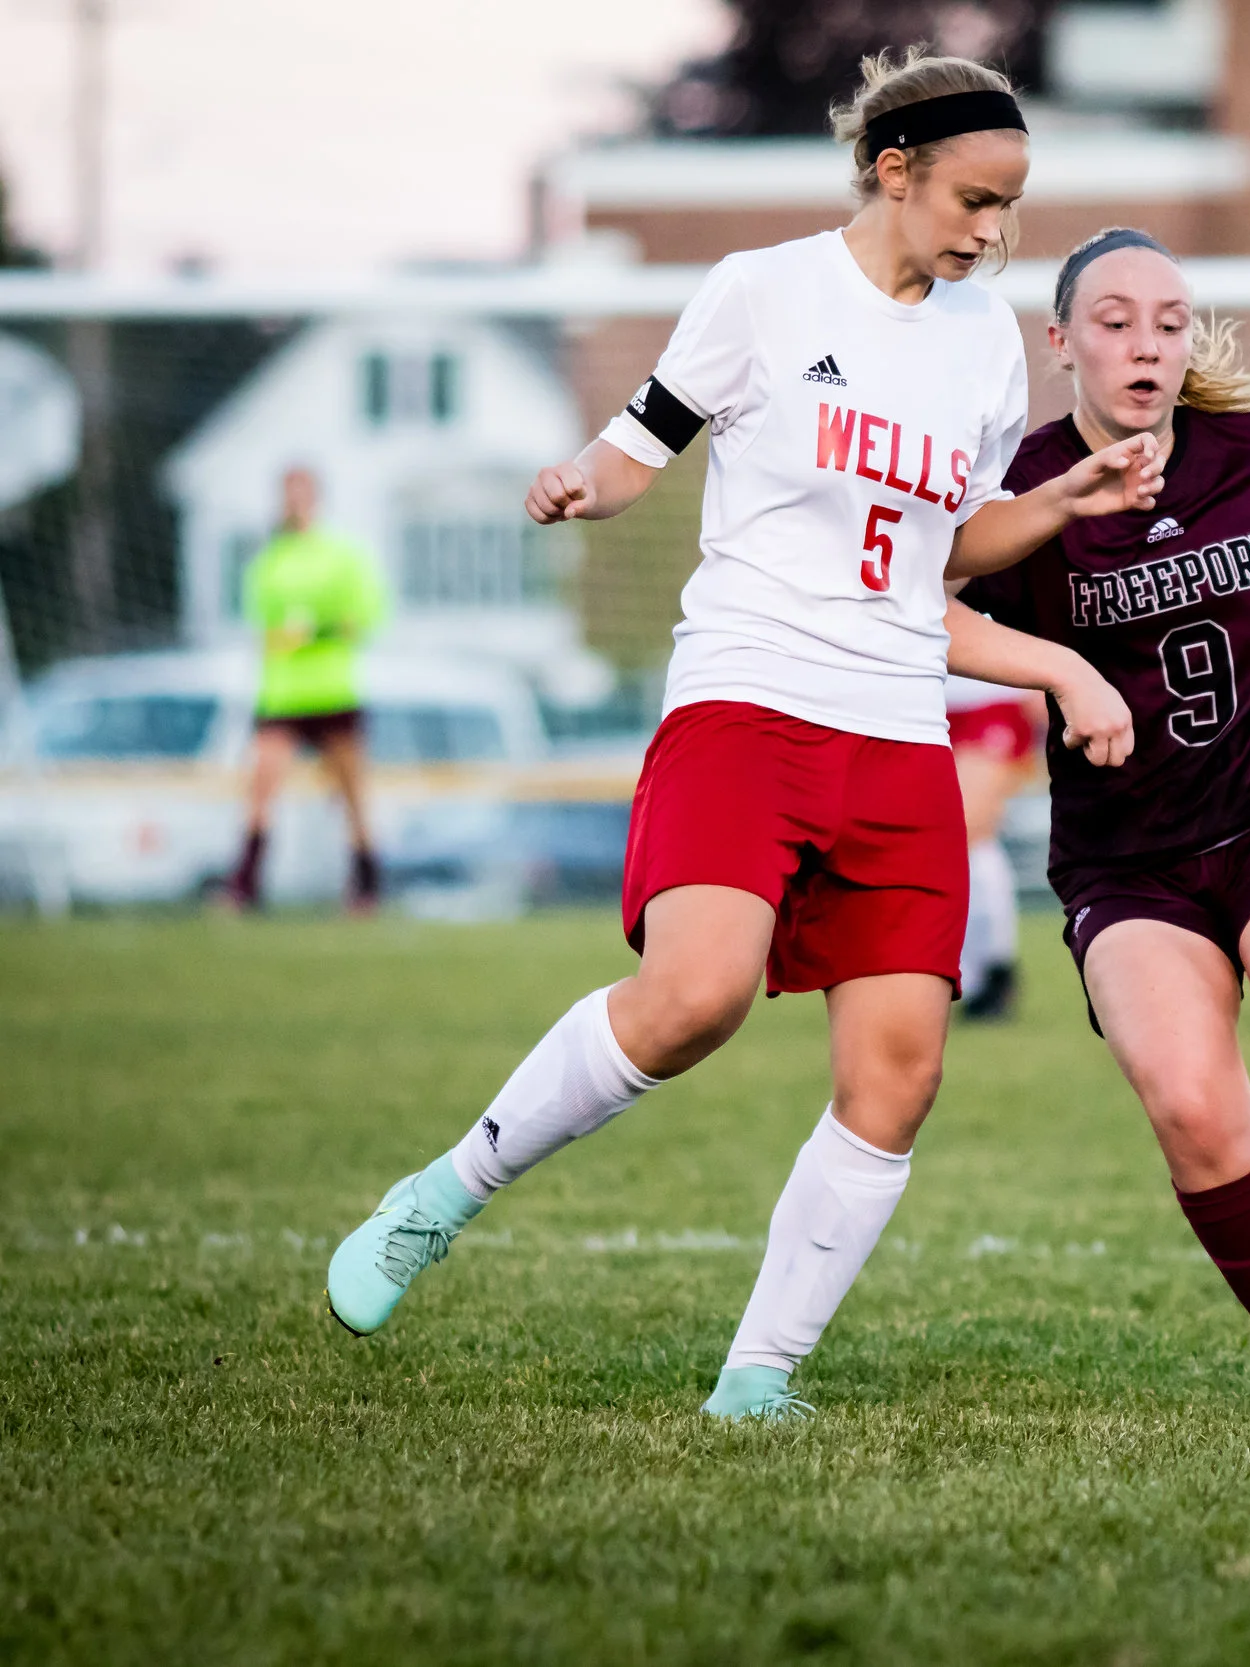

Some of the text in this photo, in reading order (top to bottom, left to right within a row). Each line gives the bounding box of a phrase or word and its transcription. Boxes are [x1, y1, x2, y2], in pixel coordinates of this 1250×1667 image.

[802, 372, 847, 387] adidas
[816, 402, 972, 514] WELLS
[860, 503, 904, 592] 5
[1147, 527, 1184, 543] adidas
[1157, 618, 1238, 747] 9
